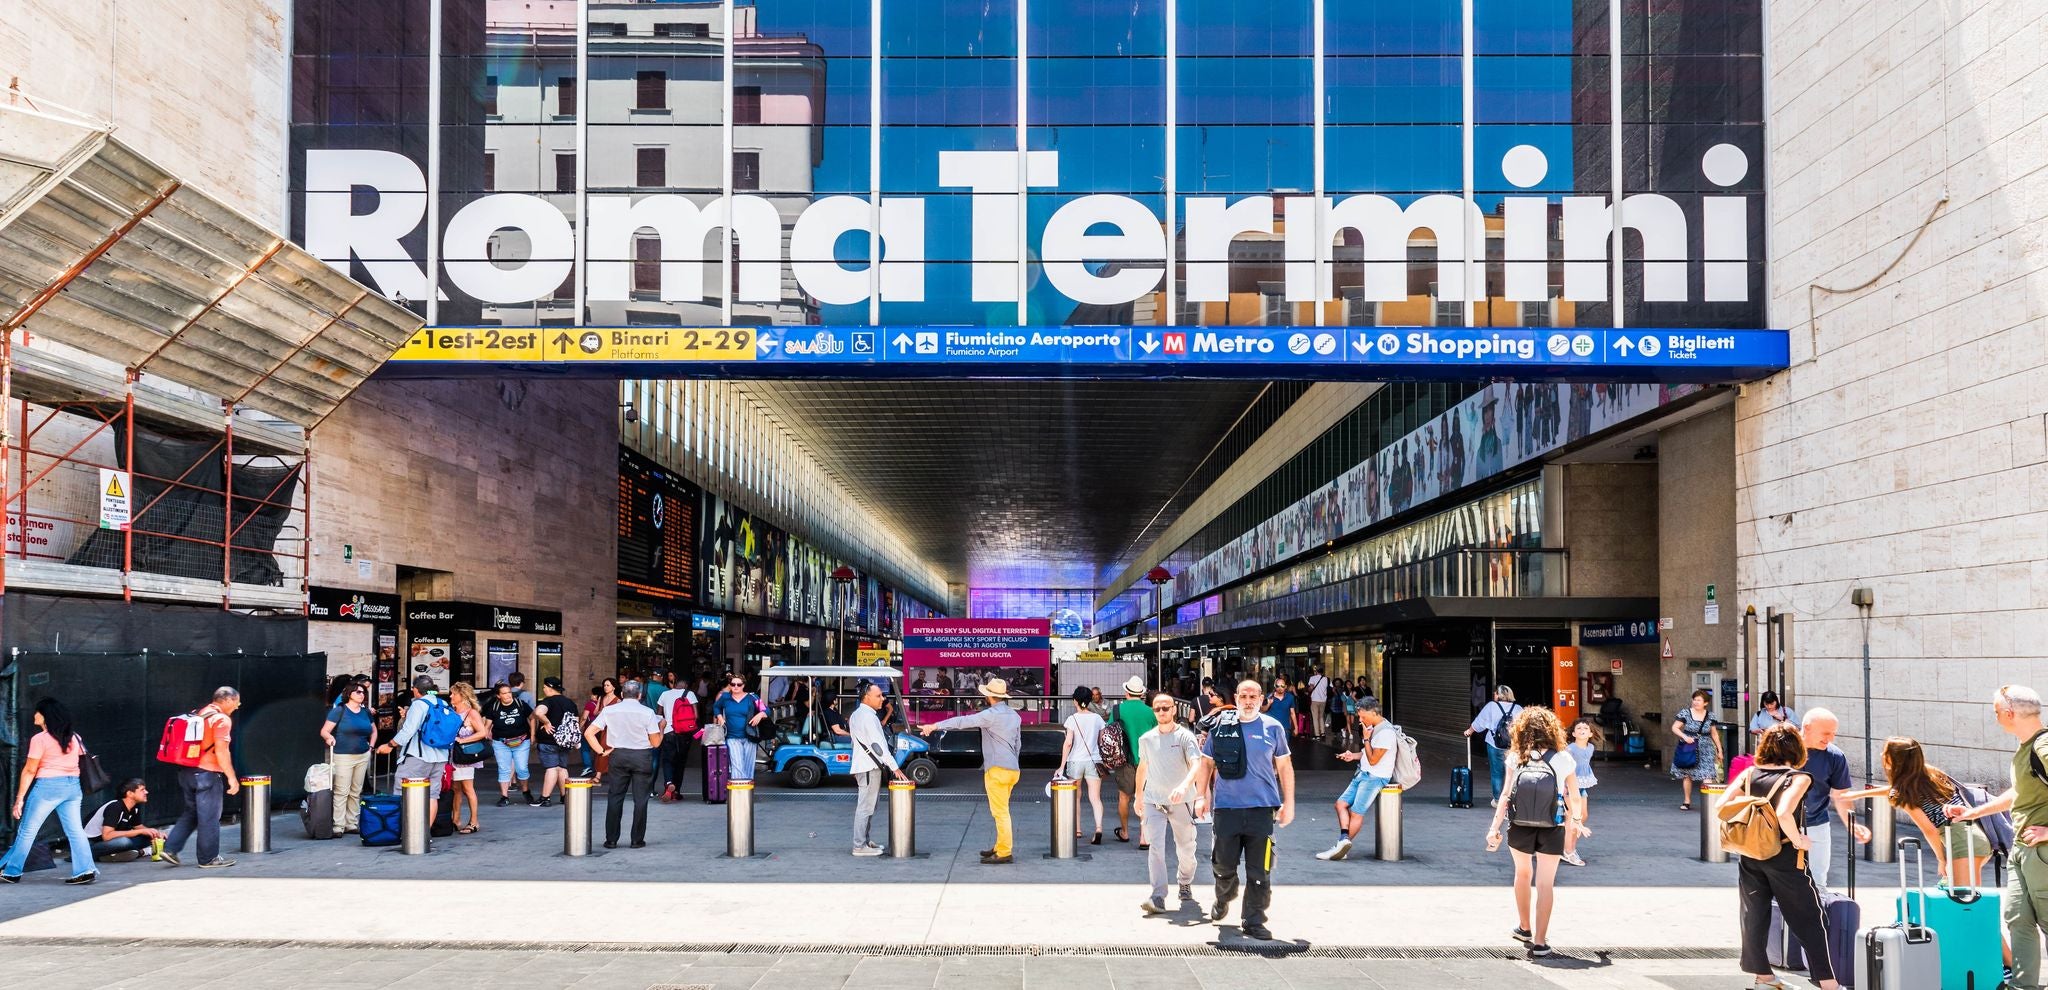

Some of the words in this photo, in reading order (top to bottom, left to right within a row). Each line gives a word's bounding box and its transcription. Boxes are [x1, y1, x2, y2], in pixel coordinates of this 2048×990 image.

[400, 329, 538, 350] -1est-2est
[611, 331, 669, 346] Binari
[683, 330, 751, 350] 2-29
[945, 331, 1026, 346] Fiumicino
[1030, 331, 1121, 349] Aeroporto
[1165, 334, 1184, 351] M
[1193, 332, 1275, 353] Metro
[1407, 332, 1534, 359] Shopping
[1668, 335, 1735, 353] Biglietti
[611, 348, 659, 361] Platforms
[945, 347, 986, 357] Fiumicino
[987, 347, 1019, 358] Airport
[1668, 350, 1697, 360] Tickets
[7, 532, 48, 546] staione
[310, 603, 329, 615] Pizza
[409, 611, 437, 620] Coffee
[438, 611, 455, 620] Bar
[493, 607, 521, 630] Roadhouse
[1583, 624, 1625, 638] Ascensore/Lift
